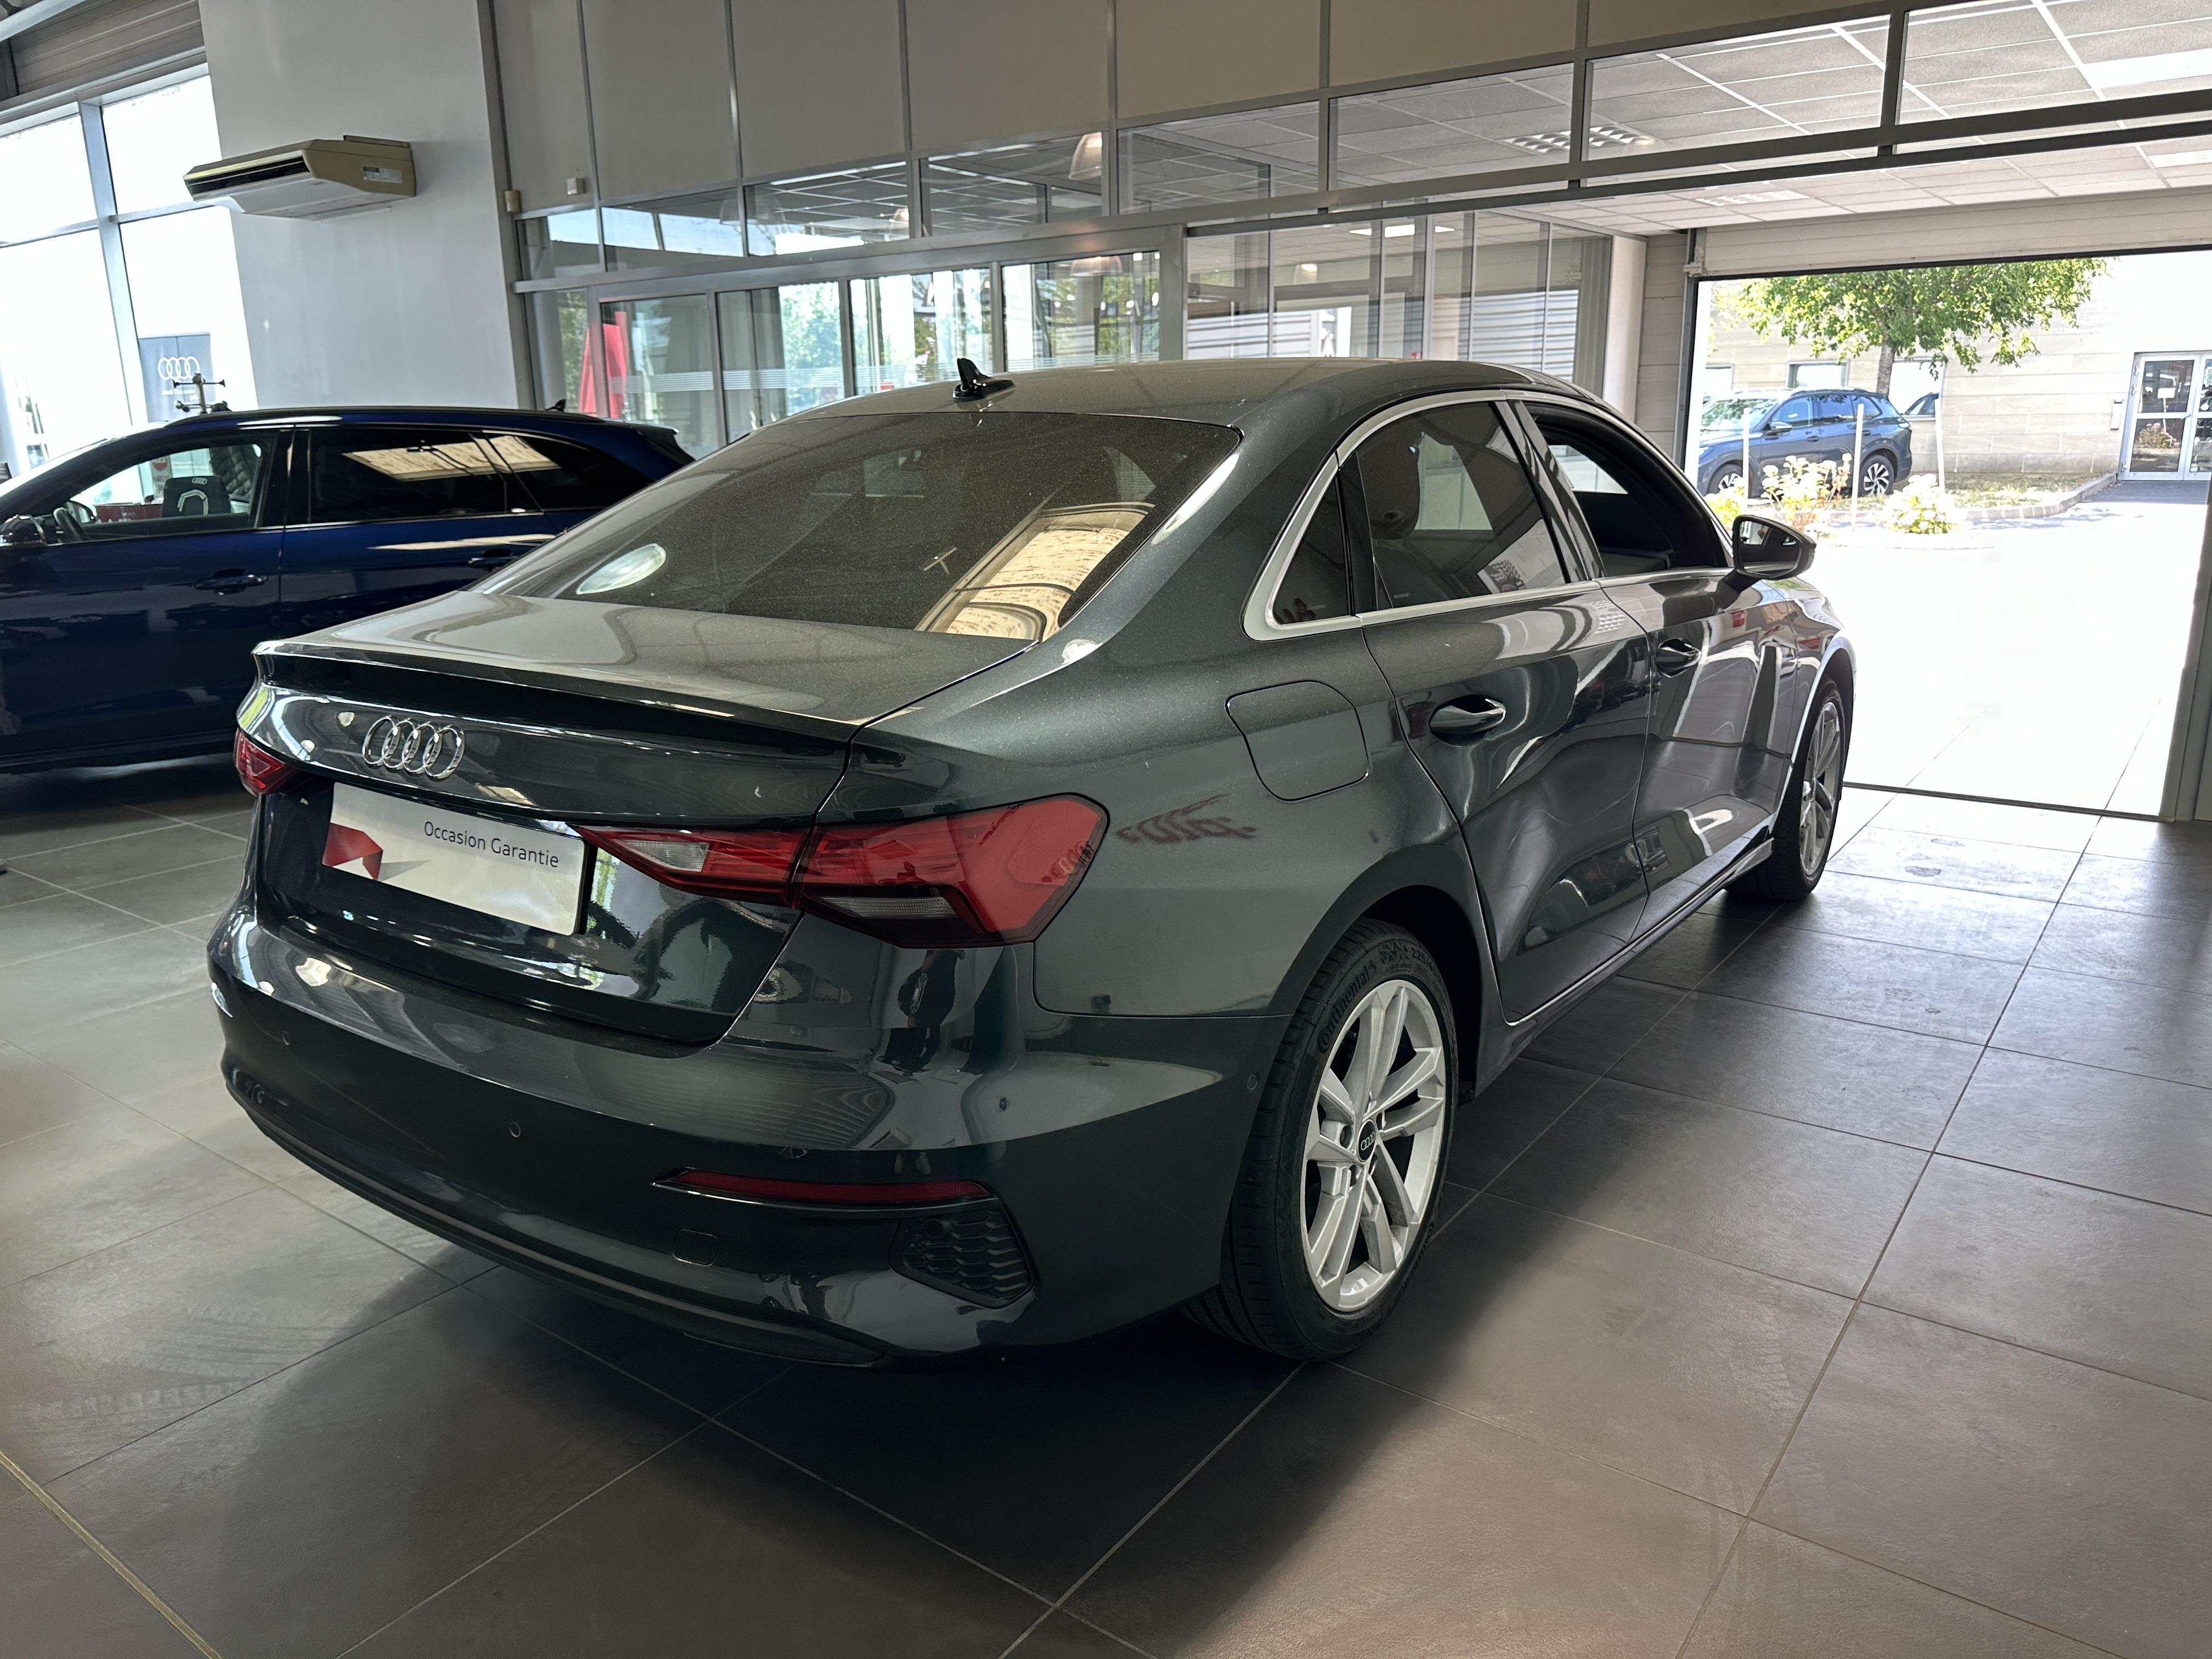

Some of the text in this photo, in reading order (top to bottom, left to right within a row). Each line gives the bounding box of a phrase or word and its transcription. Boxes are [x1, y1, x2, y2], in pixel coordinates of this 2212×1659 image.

[424, 821, 559, 868] Occasion Garantie
[1317, 965, 1370, 1053] Continental
